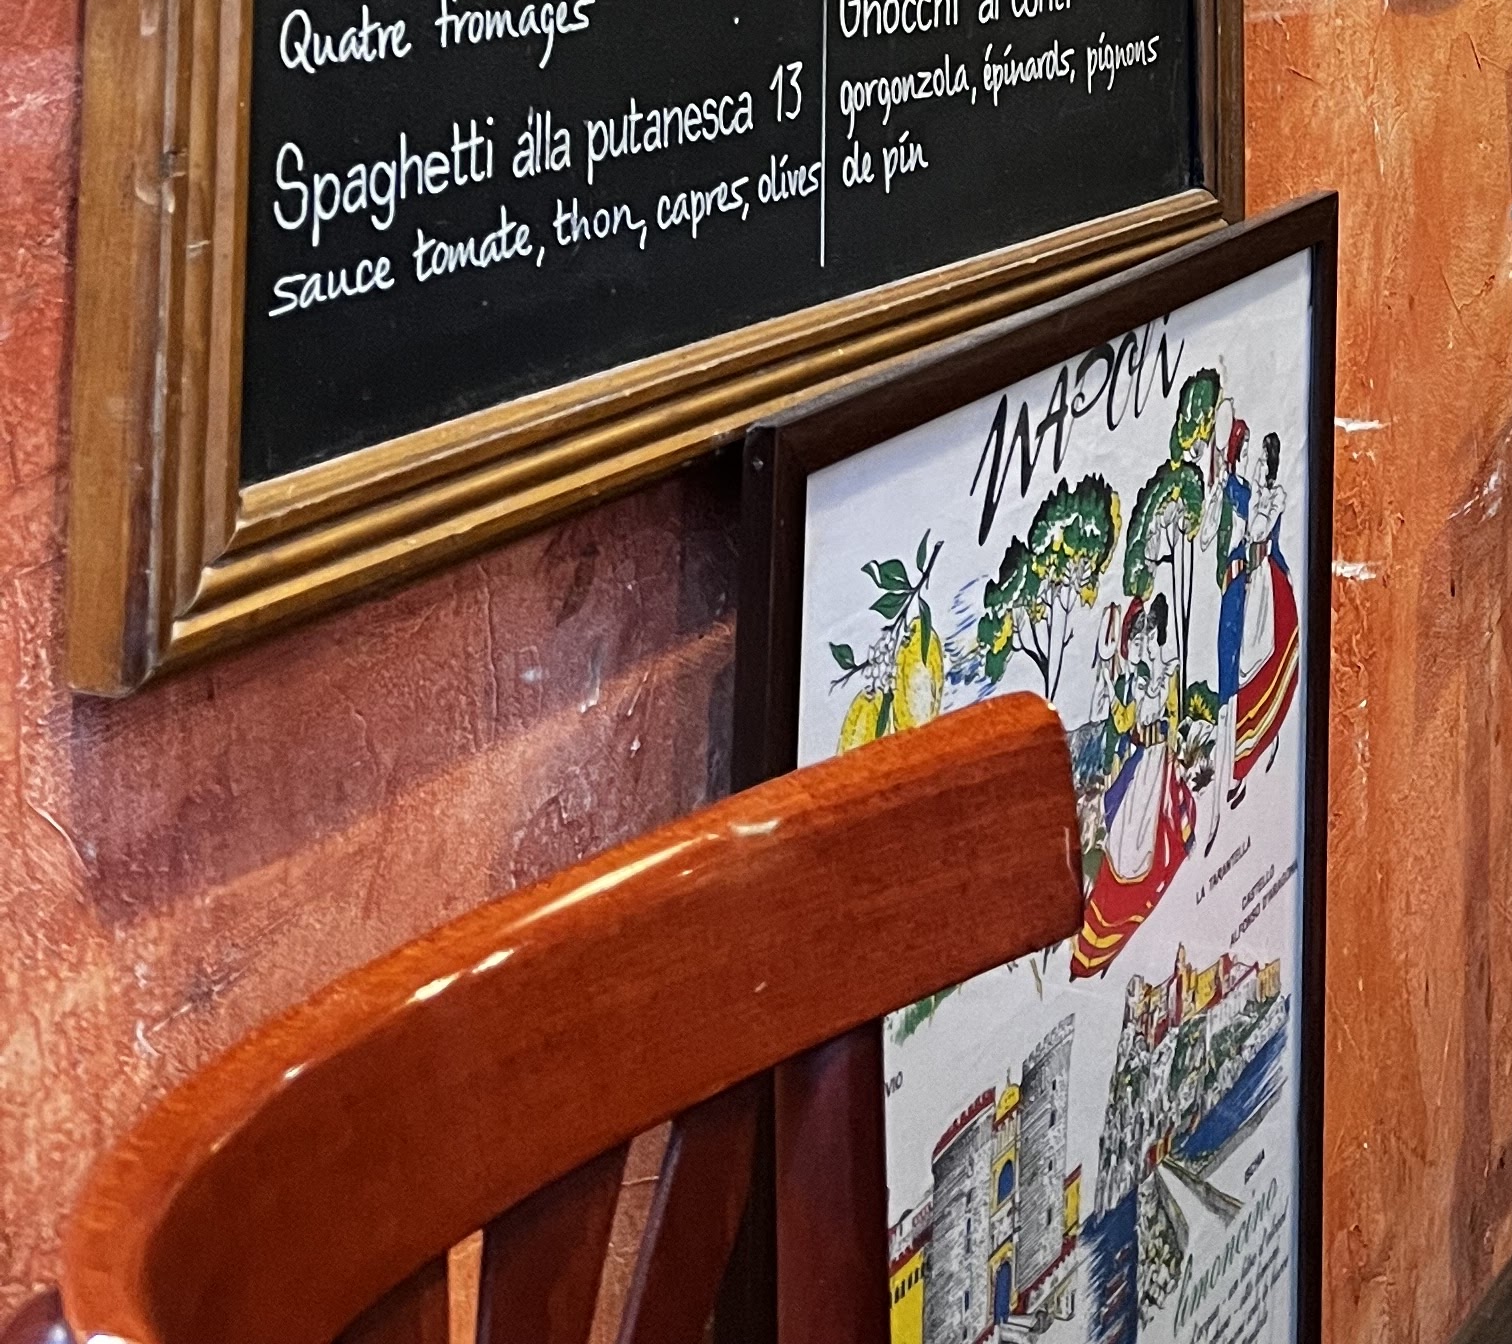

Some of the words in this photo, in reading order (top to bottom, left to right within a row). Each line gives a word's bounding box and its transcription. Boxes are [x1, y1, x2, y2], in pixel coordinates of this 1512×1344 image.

[278, 6, 412, 75] Quatre
[840, 54, 977, 141] gorgonzola,
[982, 38, 1077, 107] épinards,
[1086, 30, 1161, 95] pignons
[273, 116, 495, 248] Spaghetti
[585, 90, 754, 185] putanesca
[769, 60, 803, 122] 13
[841, 138, 875, 188] de
[883, 130, 930, 194] pin
[267, 256, 395, 317] sauce
[412, 204, 546, 282] tomate,
[553, 197, 648, 250] thon,
[656, 174, 750, 241] capres,
[757, 154, 823, 204] olives
